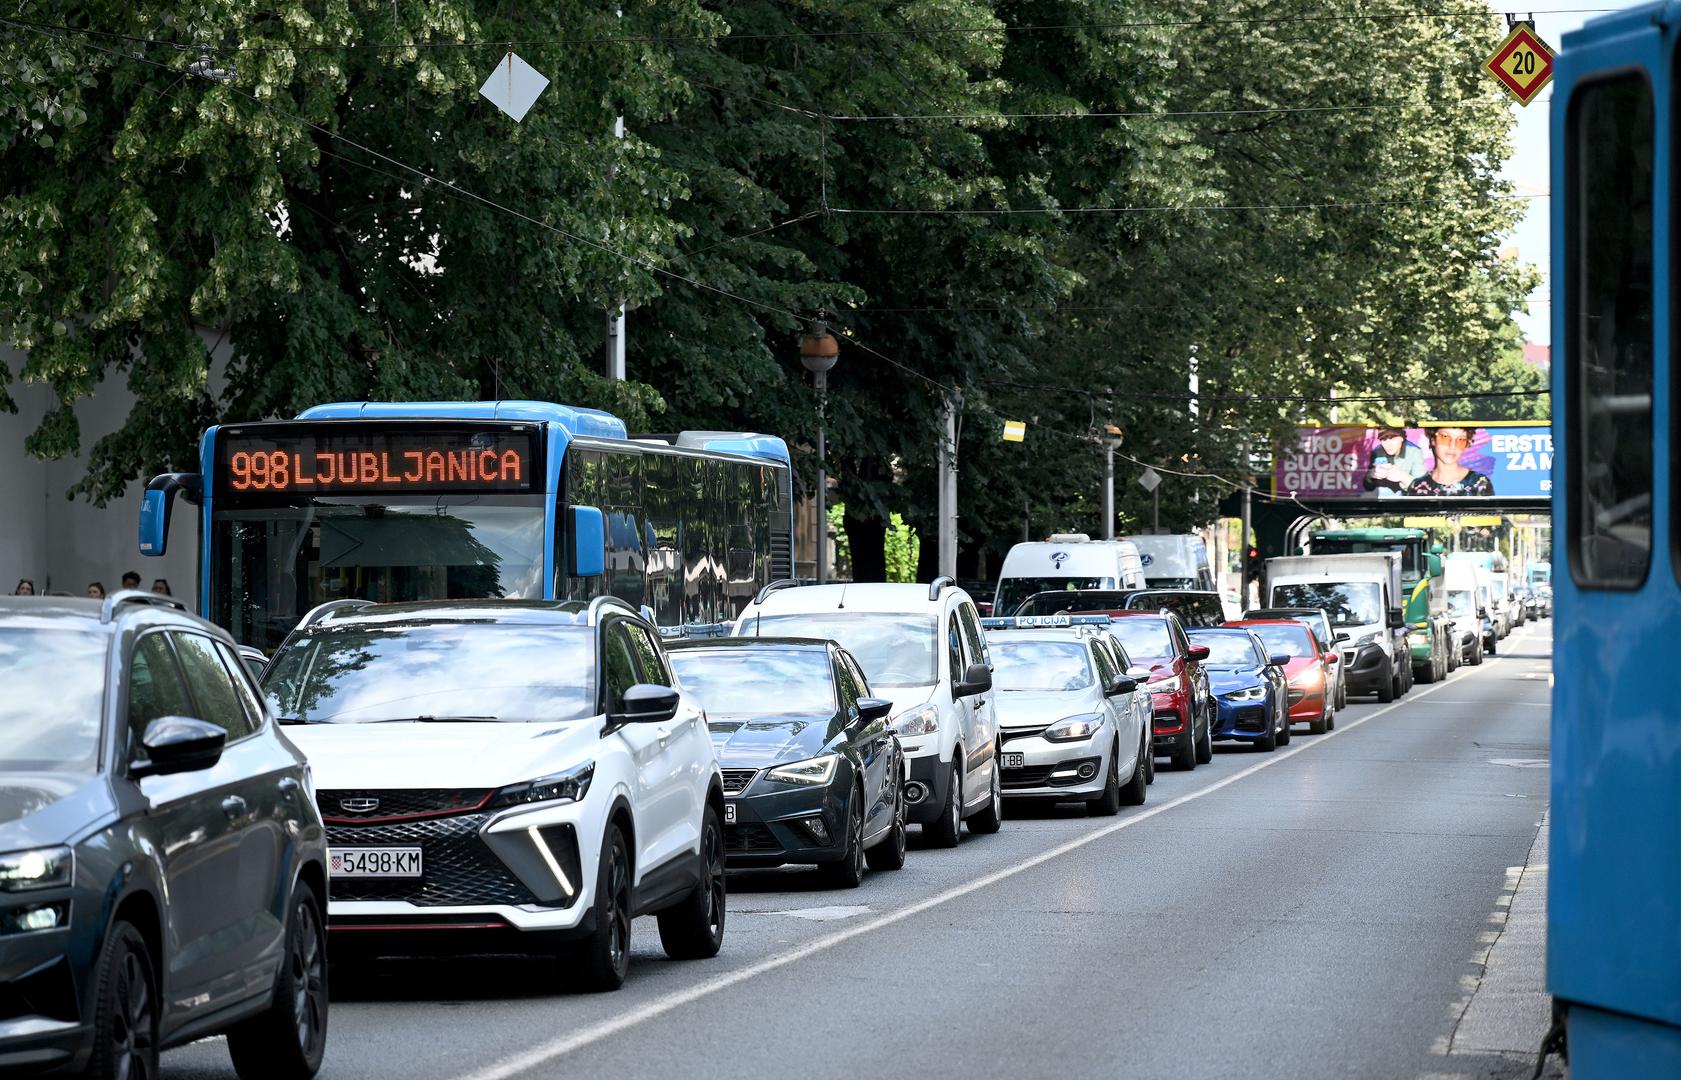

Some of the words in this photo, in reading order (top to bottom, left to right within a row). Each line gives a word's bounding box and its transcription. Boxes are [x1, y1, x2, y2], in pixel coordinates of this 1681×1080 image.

[1512, 51, 1535, 75] 20
[1298, 435, 1342, 453] ERO
[231, 451, 289, 489] 998
[294, 450, 521, 484] LJUBLJANICA
[1506, 452, 1537, 470] ZA
[1284, 471, 1358, 489] GIVEN.
[343, 852, 420, 873] 5498-KM
